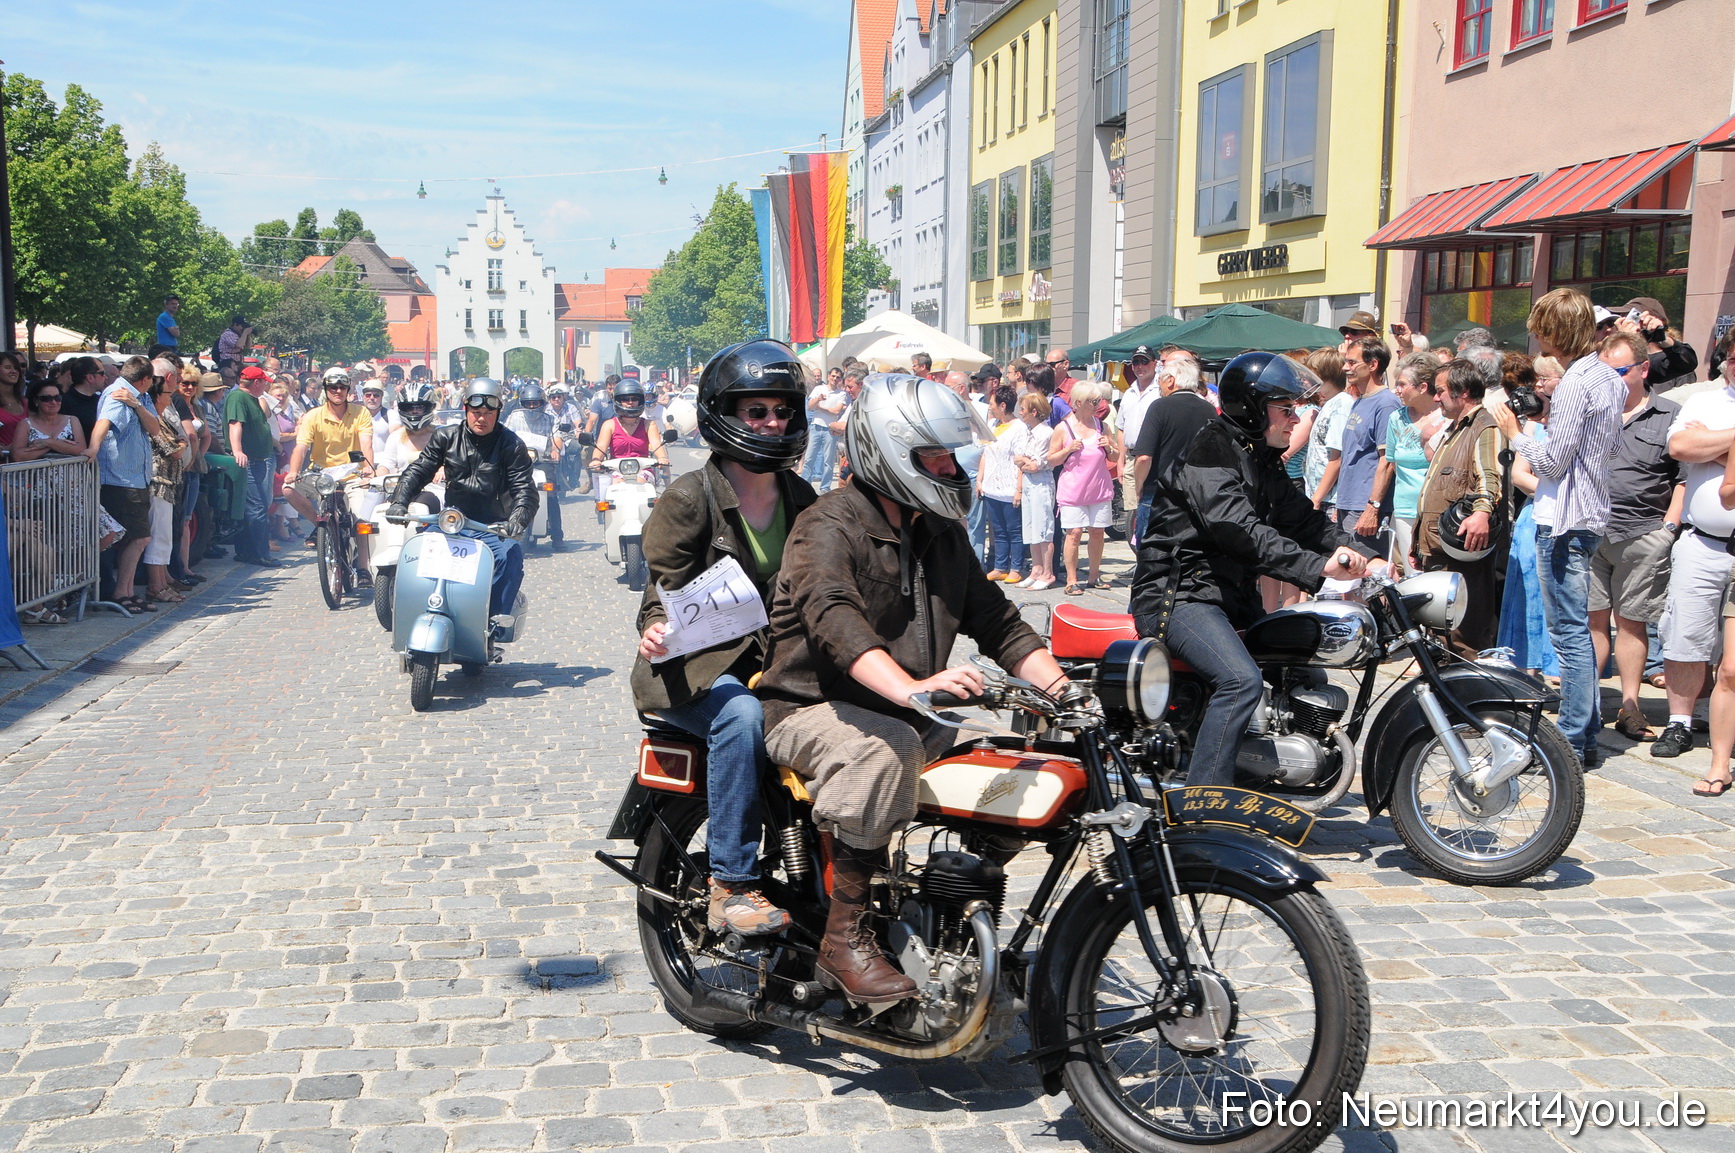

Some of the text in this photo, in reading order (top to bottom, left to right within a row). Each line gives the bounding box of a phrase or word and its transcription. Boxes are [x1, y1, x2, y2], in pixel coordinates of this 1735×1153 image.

[1217, 244, 1288, 275] GERRY WEBER
[451, 546, 468, 559] 20
[683, 580, 740, 626] 211
[1182, 788, 1223, 799] 500 ccm
[1183, 797, 1230, 811] 13,5 PS
[1264, 806, 1301, 824] 1928
